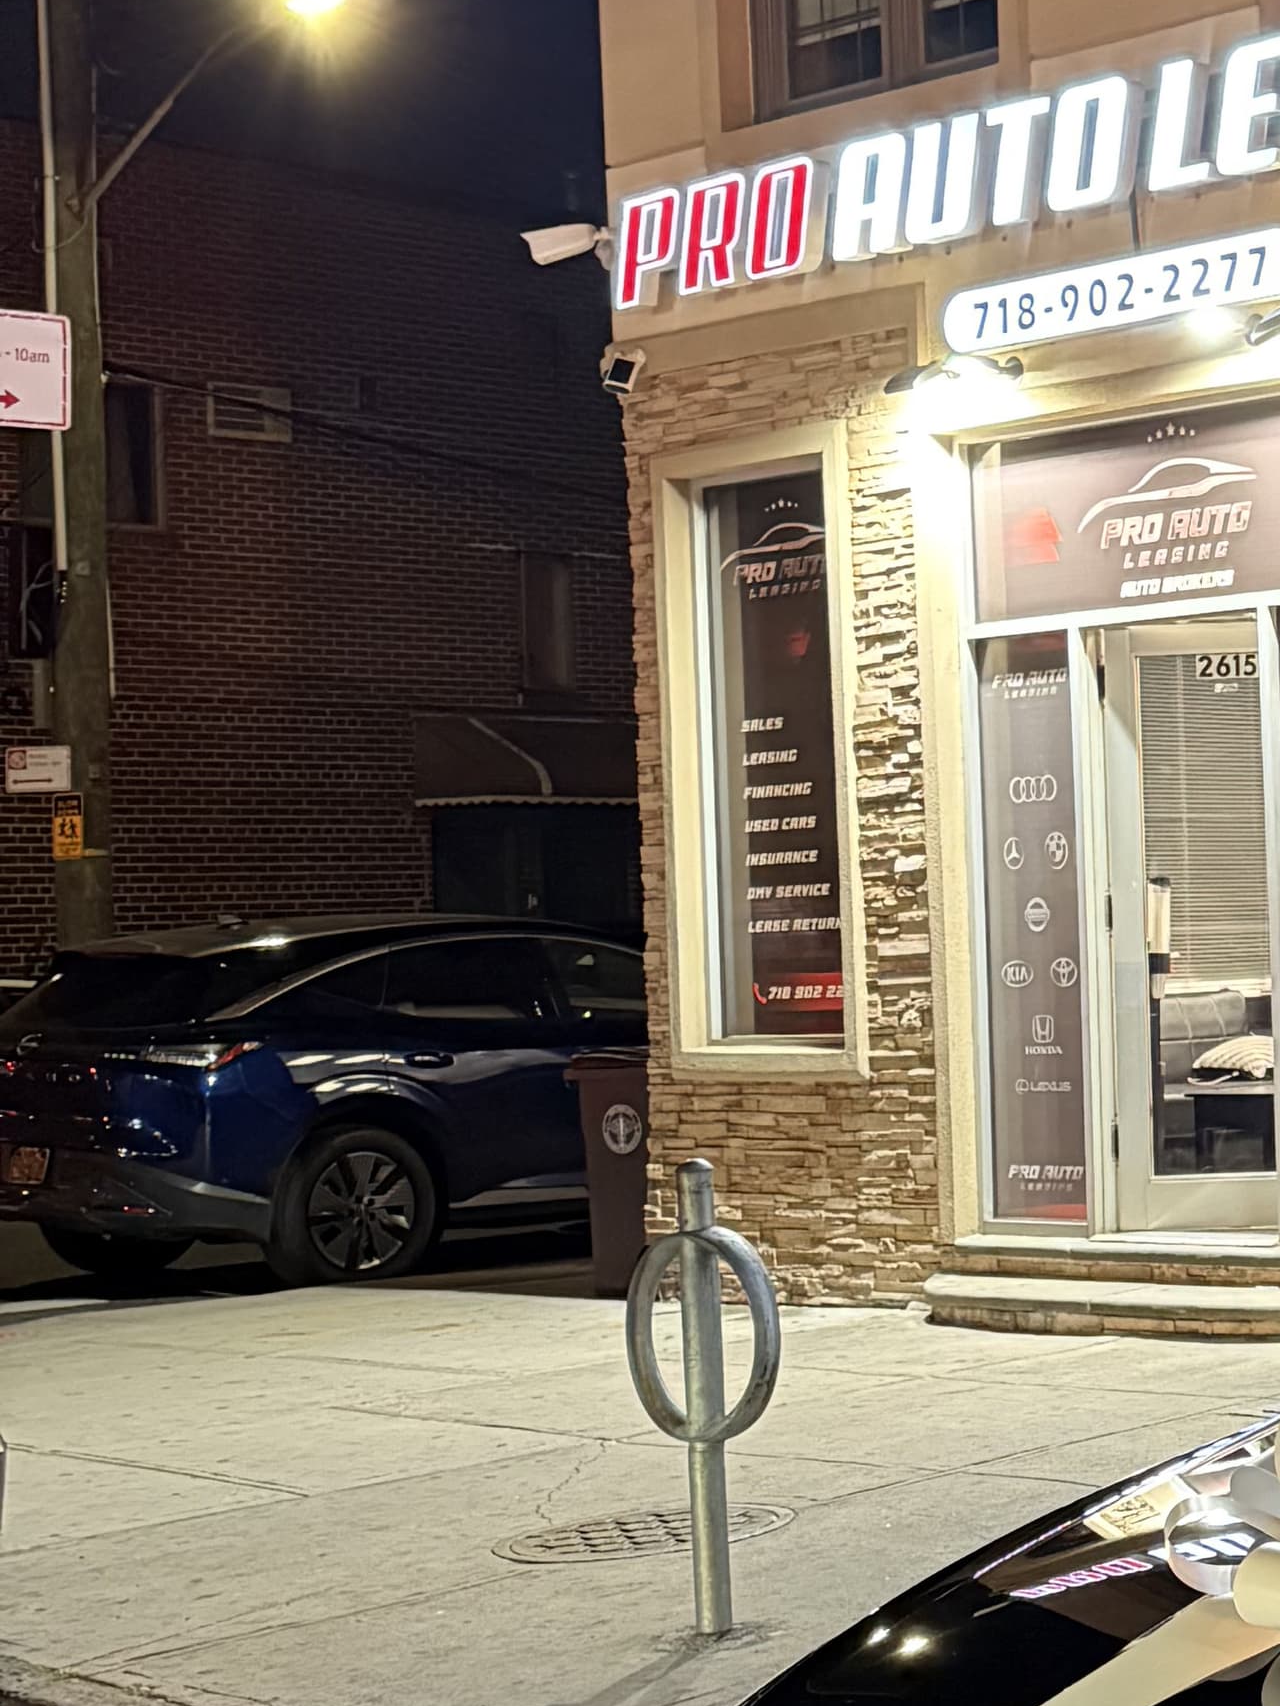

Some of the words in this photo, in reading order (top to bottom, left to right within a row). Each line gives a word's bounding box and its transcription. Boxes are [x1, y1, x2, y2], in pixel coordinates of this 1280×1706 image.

[613, 155, 814, 310] PRO
[832, 76, 1131, 261] AUTO
[974, 246, 1267, 339] 718-902-2277
[1100, 511, 1163, 550] PRO
[1168, 501, 1252, 540] AUTO
[1123, 541, 1229, 569] LEASING
[734, 561, 776, 585] PRO
[780, 553, 827, 579] AUT
[1198, 655, 1257, 677] 2615
[741, 717, 784, 732] SALES
[742, 749, 798, 766] LEASING
[743, 782, 812, 800] FINANCING
[745, 818, 779, 833] USED
[781, 816, 817, 830] CARS
[746, 850, 818, 866] INSURANCE
[747, 886, 773, 900] DMV
[776, 883, 831, 898] SERVICE
[748, 919, 789, 934] LEASE
[795, 985, 822, 999] 902
[1025, 1045, 1063, 1055] HONDA
[1008, 1164, 1040, 1180] PRO
[1043, 1165, 1084, 1181] AUTO
